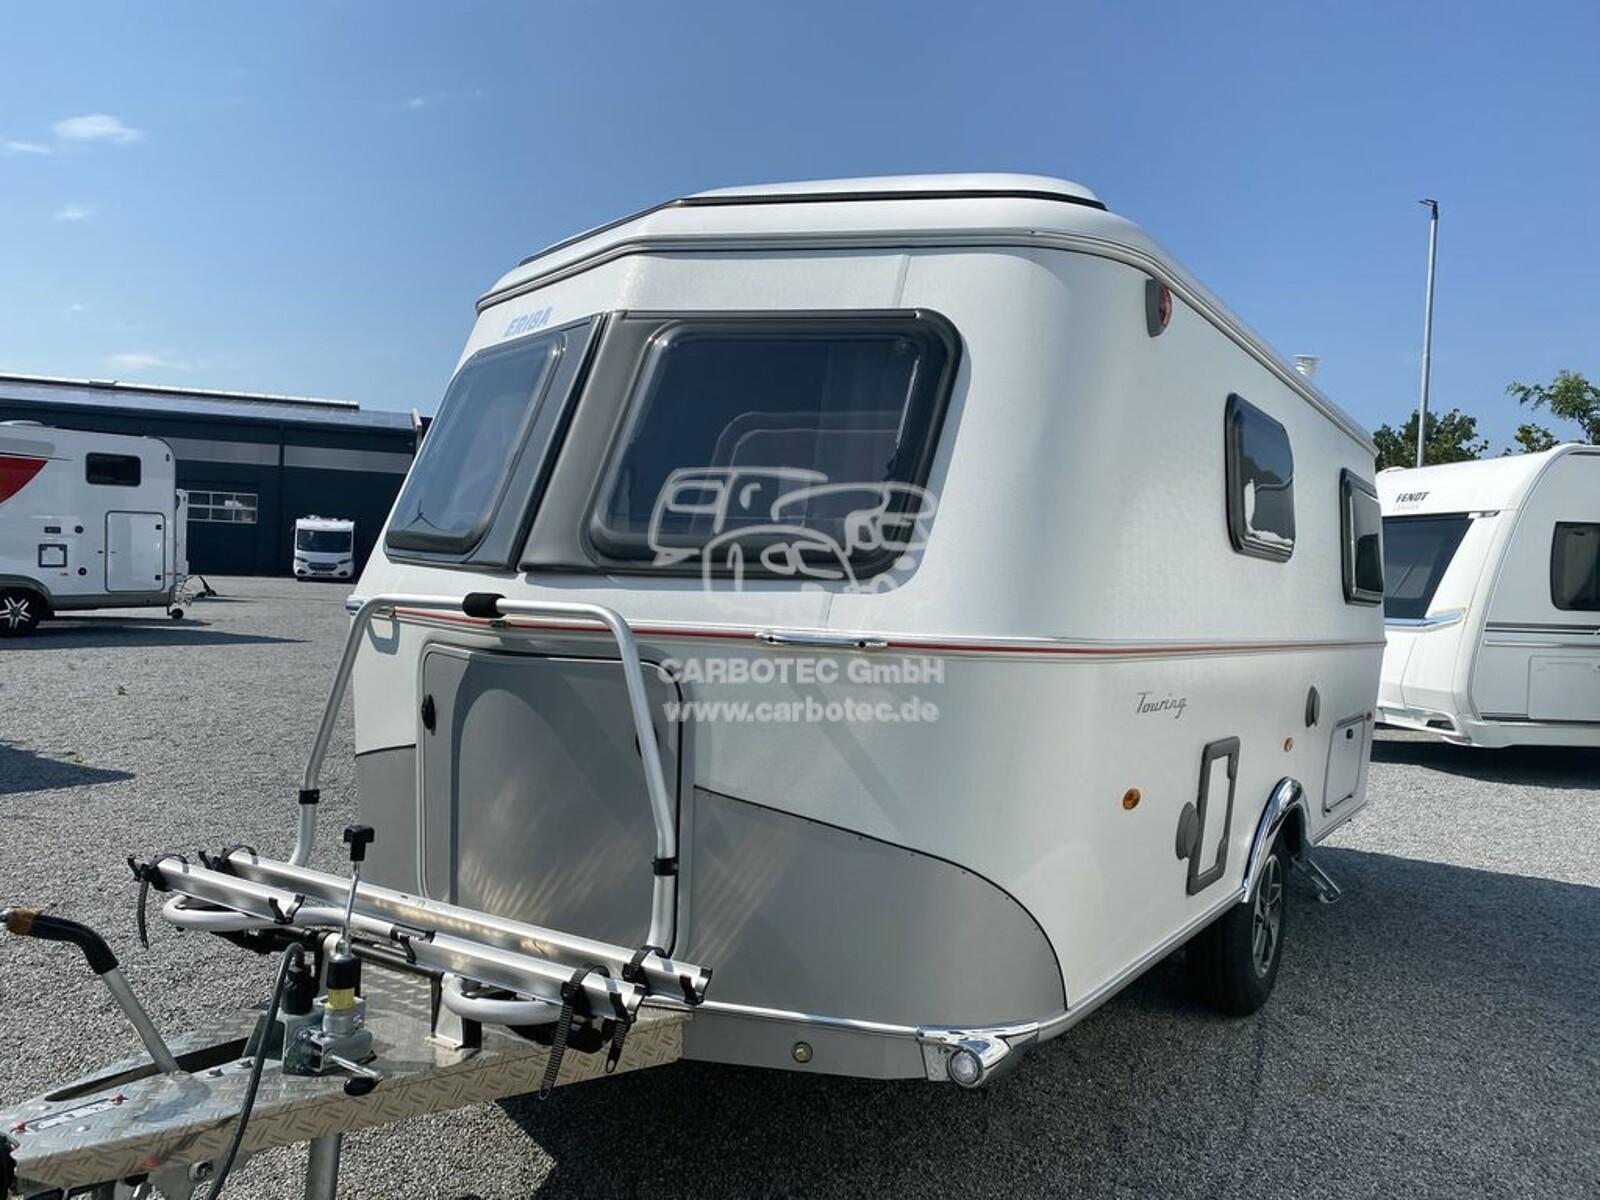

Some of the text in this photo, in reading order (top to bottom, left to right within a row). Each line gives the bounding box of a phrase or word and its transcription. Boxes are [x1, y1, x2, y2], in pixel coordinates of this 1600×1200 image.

[504, 306, 553, 336] ERIBA
[1396, 491, 1430, 503] FENDT
[1136, 691, 1188, 719] Touring
